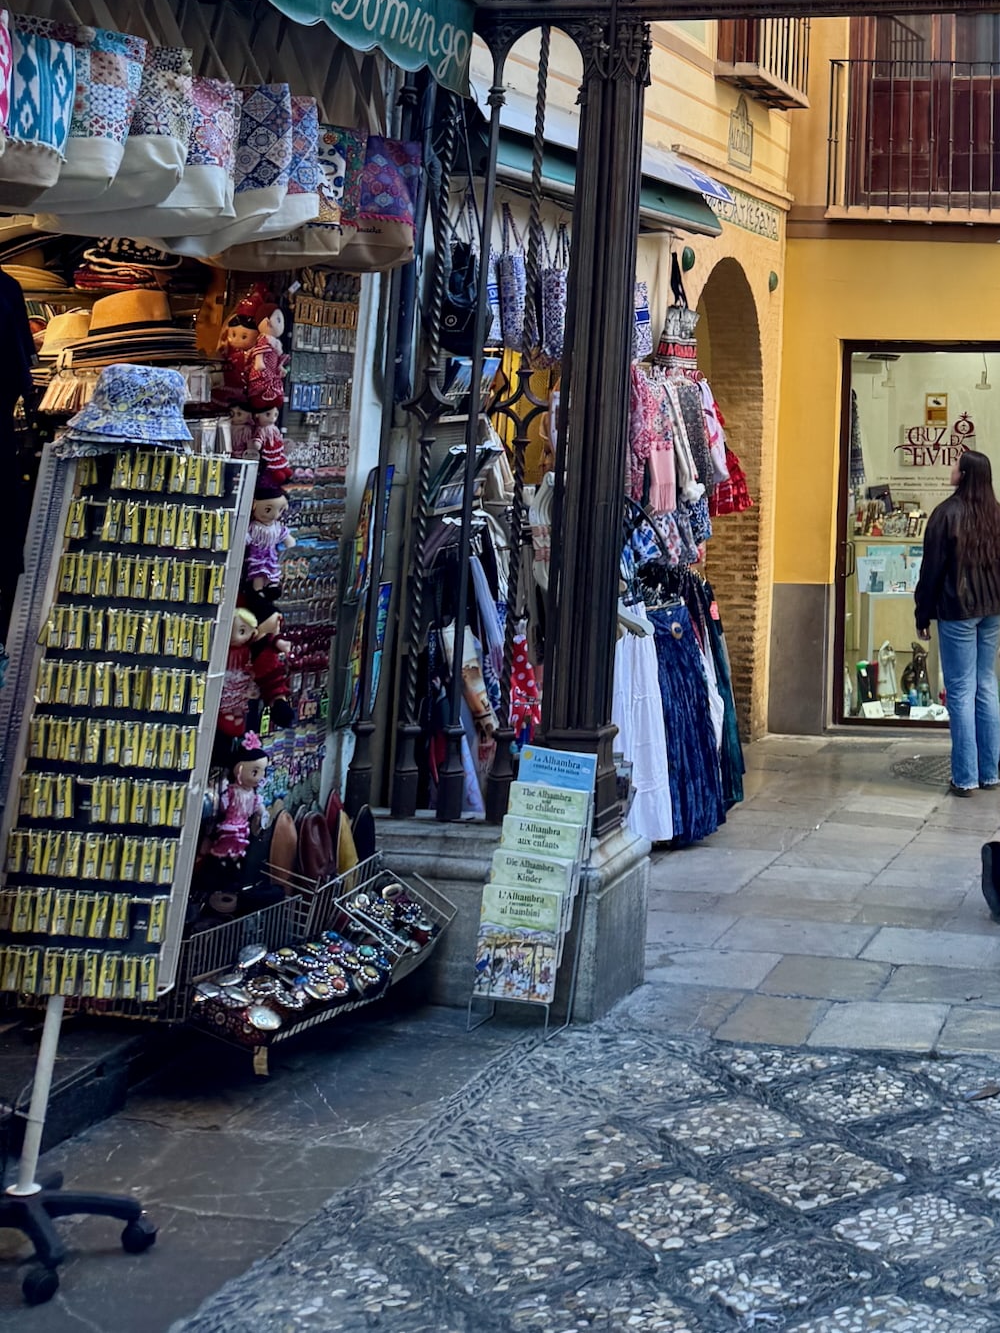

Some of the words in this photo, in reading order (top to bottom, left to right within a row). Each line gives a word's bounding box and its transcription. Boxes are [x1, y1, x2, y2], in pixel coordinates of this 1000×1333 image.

[907, 426, 947, 446] CRUZ
[542, 755, 581, 770] Alhambra
[522, 788, 536, 797] The
[537, 789, 572, 803] Alhambra
[535, 803, 566, 815] children
[519, 822, 561, 836] L'Alhambra
[517, 837, 532, 846] aux
[533, 838, 560, 850] enfants
[505, 857, 518, 867] Die
[519, 859, 555, 873] Alhambra
[516, 873, 543, 884] Kinder
[498, 889, 545, 904] L'Alhambra
[509, 907, 541, 919] bambini
